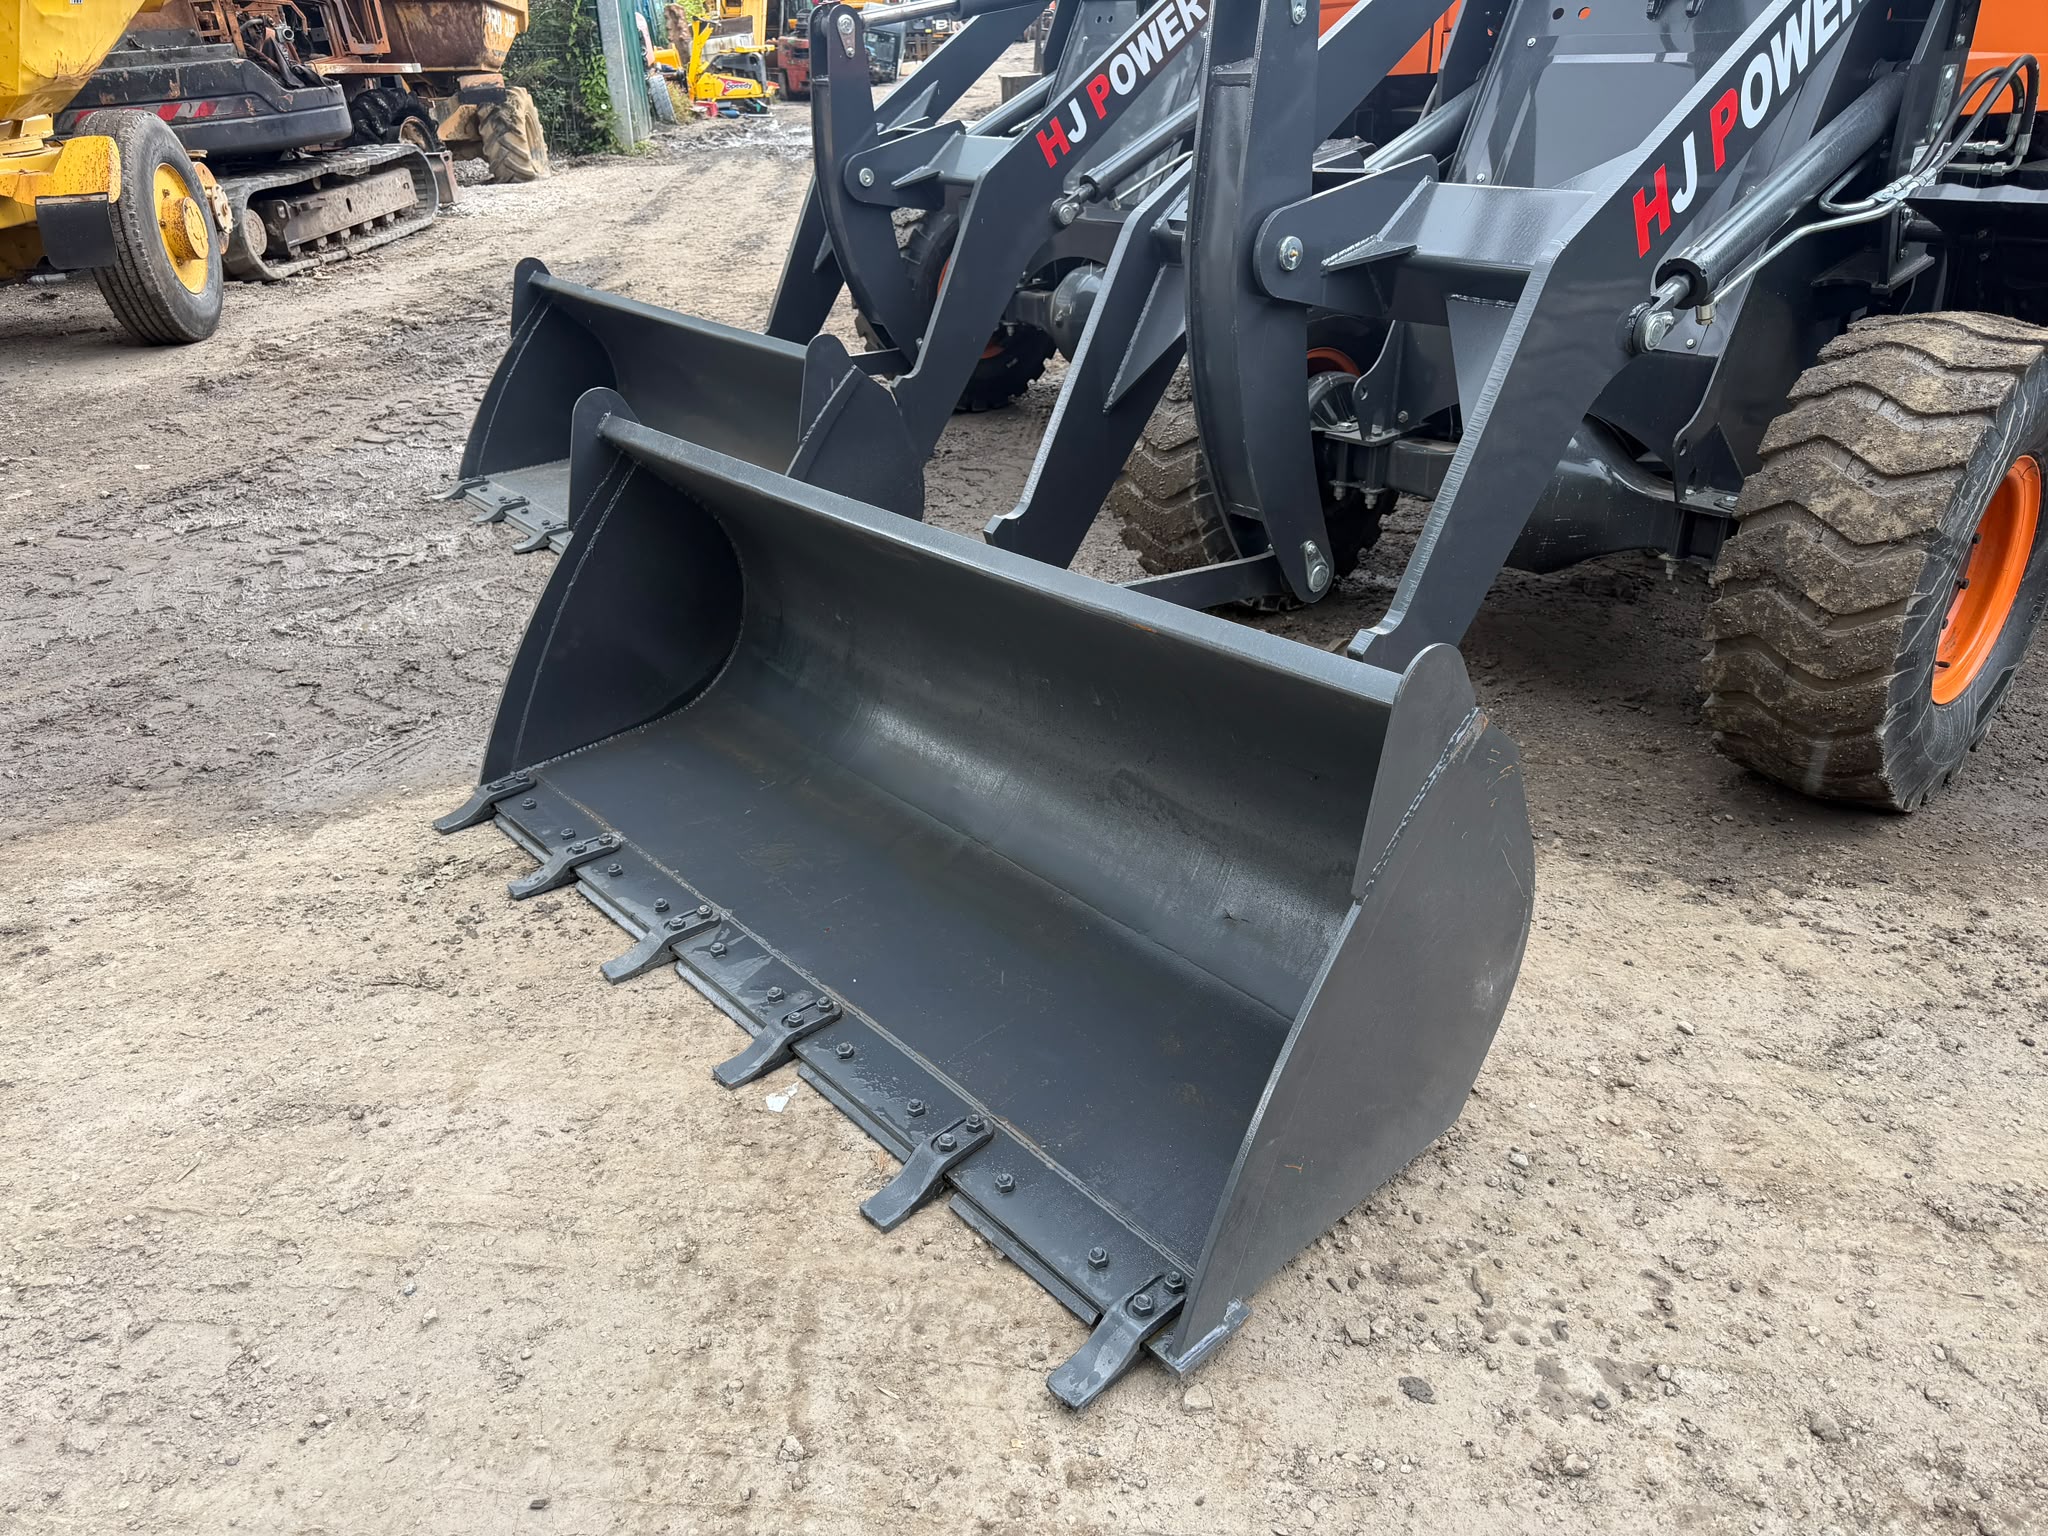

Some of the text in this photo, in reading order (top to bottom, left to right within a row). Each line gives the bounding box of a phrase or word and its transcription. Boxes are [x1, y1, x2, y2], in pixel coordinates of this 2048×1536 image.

[726, 81, 752, 89] Speedy
[1035, 0, 1207, 168] HJ POWER
[1632, 131, 1698, 259] HJ
